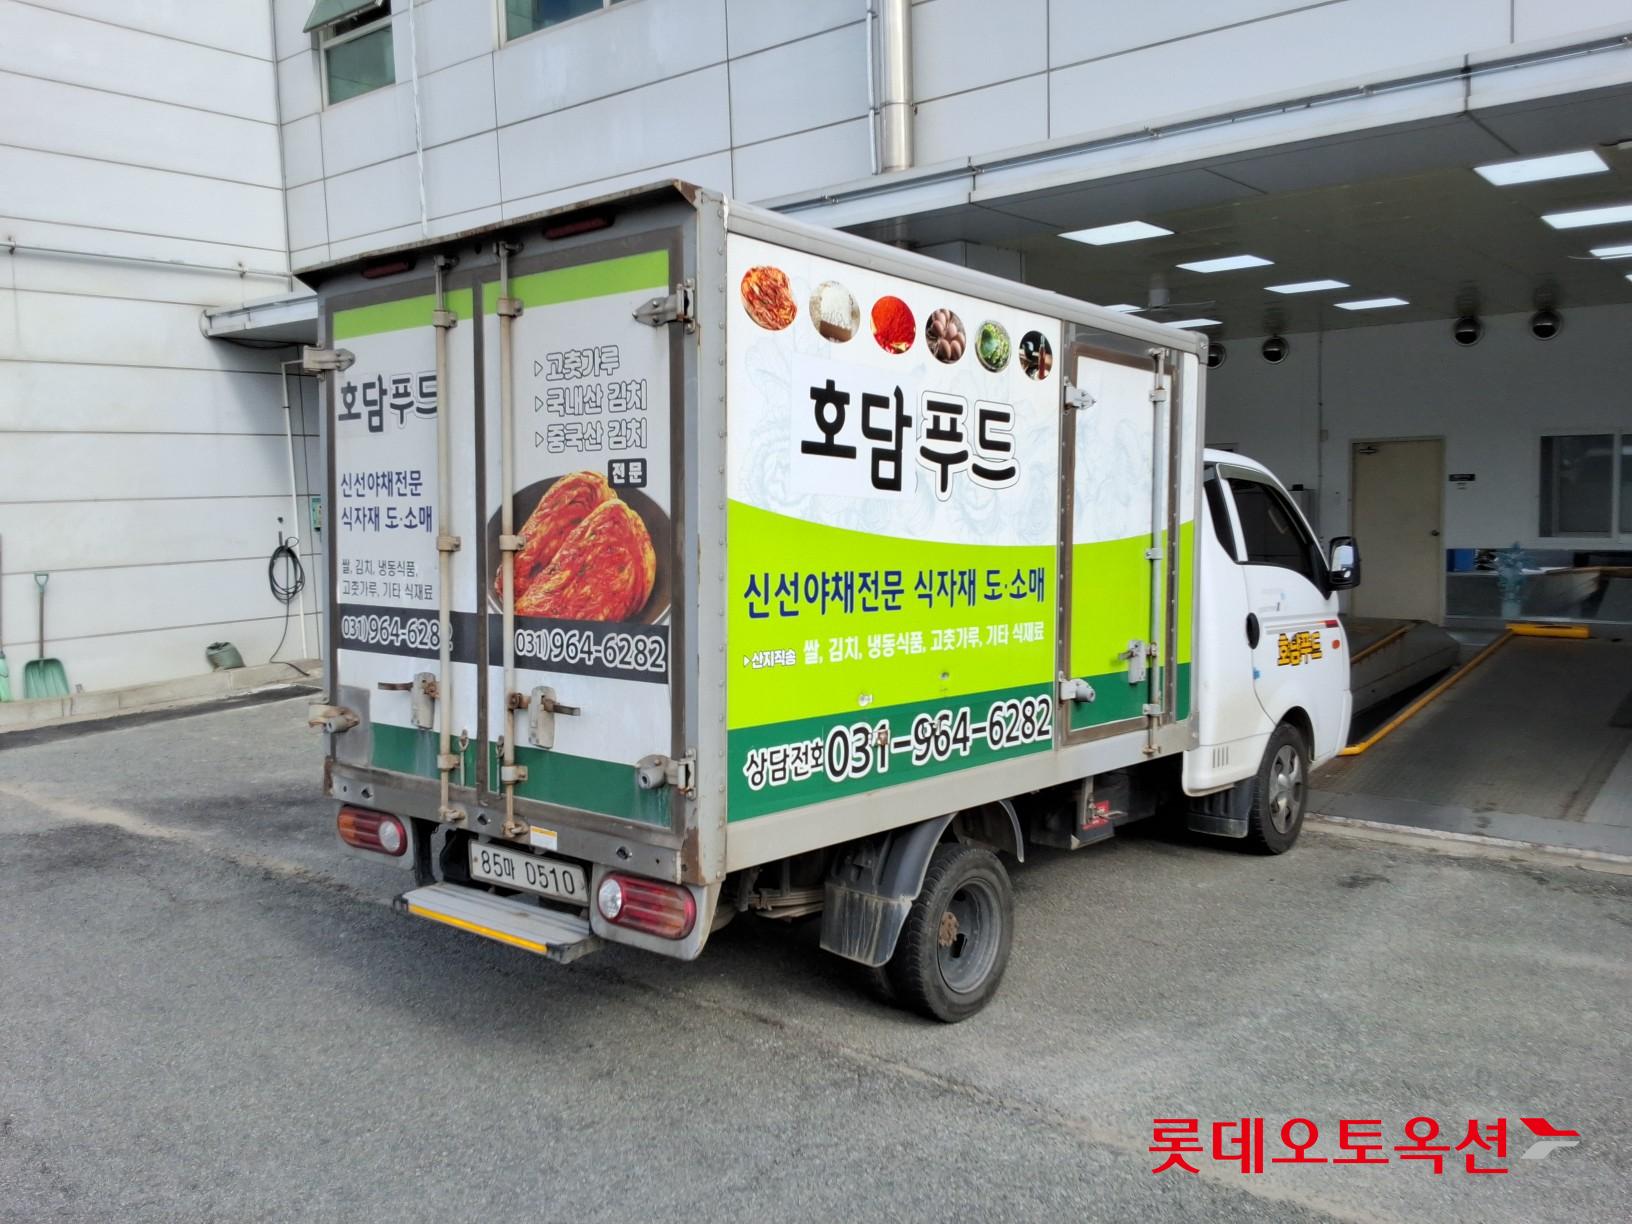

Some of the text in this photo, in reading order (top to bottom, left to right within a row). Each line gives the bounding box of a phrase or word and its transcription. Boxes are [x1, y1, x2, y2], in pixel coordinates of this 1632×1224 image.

[546, 345, 620, 381] 고춧가루
[338, 374, 438, 433] 호담푸드
[546, 378, 647, 417] 국내산 김치
[546, 417, 647, 453] 중국산 김치
[801, 379, 1017, 492] 호담푸드
[341, 470, 422, 497] 신선야채전문
[341, 506, 379, 532] 식자재
[356, 559, 375, 575] 김치,
[378, 559, 418, 577] 냉동식품,
[383, 582, 400, 599] 기타
[405, 583, 433, 600] 식재료
[743, 571, 905, 619] 신선야채전문
[914, 569, 976, 608] 식자재
[515, 628, 666, 672] 031)964-6282
[751, 649, 797, 669] 산지직송
[828, 636, 863, 663] 김치,
[867, 632, 927, 660] 냉동식품,
[986, 624, 1009, 646] 기타
[1012, 621, 1045, 644] 식재료
[481, 850, 575, 895] 85마 0510
